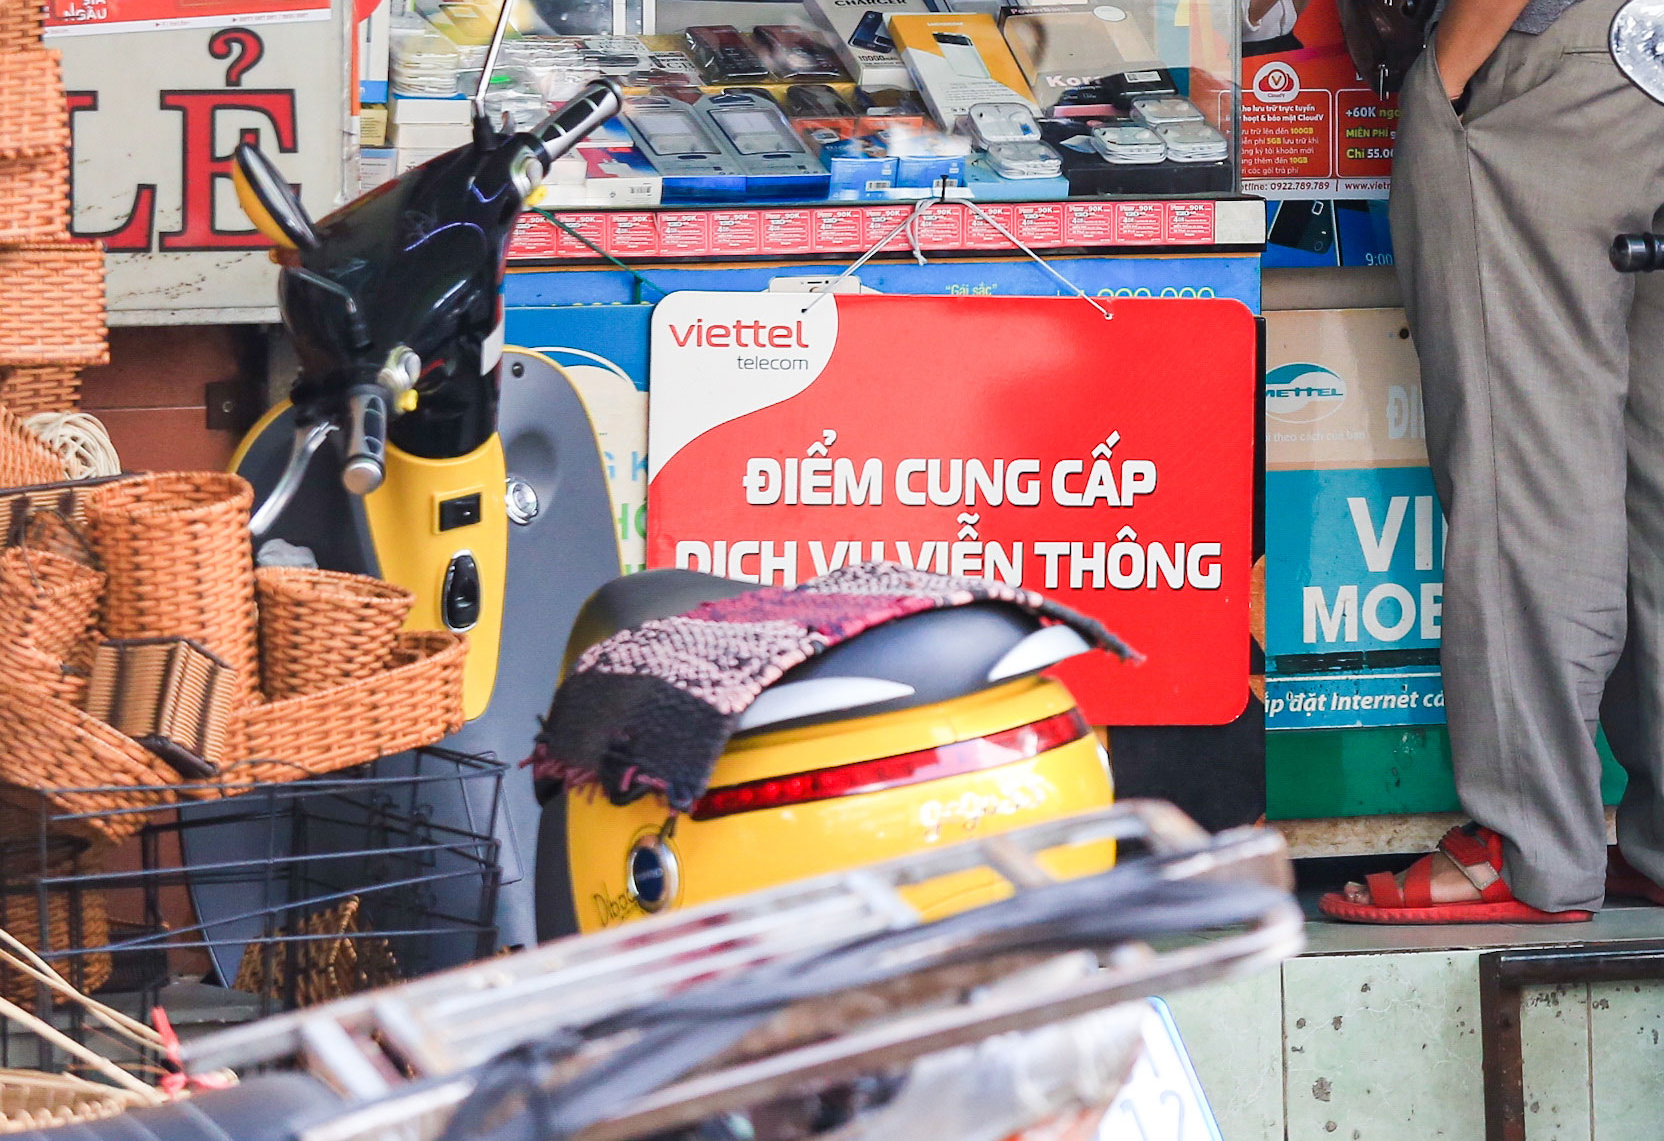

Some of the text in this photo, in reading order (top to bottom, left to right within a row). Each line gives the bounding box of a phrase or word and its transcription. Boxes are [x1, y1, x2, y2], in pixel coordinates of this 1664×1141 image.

[1346, 107, 1376, 118] +60K
[1271, 182, 1329, 191] 0922.789.789
[669, 319, 809, 349] viettel
[737, 354, 809, 371] telecom
[742, 429, 1157, 507] ĐIỂM CUNG CẤP
[908, 513, 1222, 590] VIỄN THÔNG
[1331, 689, 1418, 711] Internet
